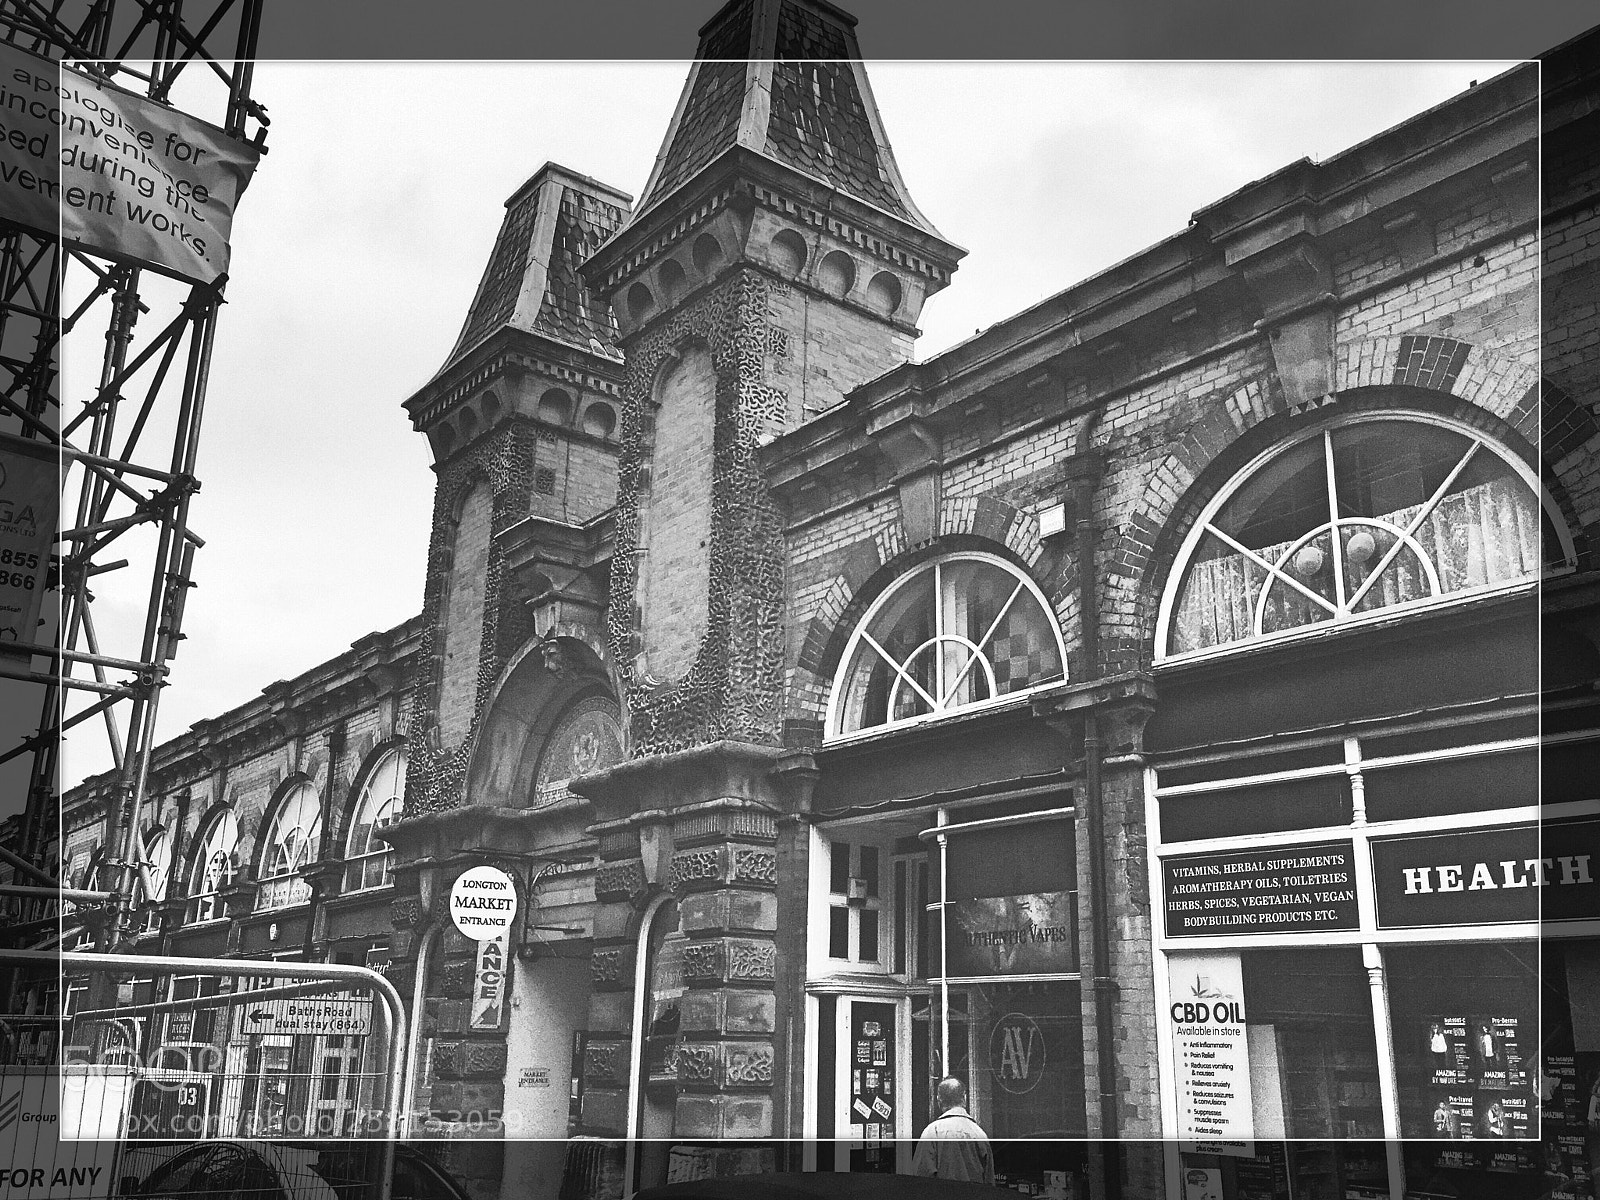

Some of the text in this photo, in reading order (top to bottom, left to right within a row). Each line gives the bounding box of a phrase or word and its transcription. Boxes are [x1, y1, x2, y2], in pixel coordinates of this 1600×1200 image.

[164, 133, 207, 165] for
[59, 144, 155, 198] during
[126, 200, 211, 262] works.
[1172, 854, 1345, 878] VITAMINS, HERBAL SUPPLEMENTS
[1402, 855, 1594, 895] HEALTH
[462, 880, 507, 890] LONGTON
[1172, 872, 1348, 895] AROMATHERAPY OILS, TOILETRIES
[454, 896, 514, 911] MARKET
[1168, 890, 1354, 911] HERBS, SPICES, VEGETARIAN, VEGAN
[459, 916, 506, 927] ENTRANCE
[1184, 909, 1338, 927] BODYBUILDING PRODUCTS ETC.
[288, 1006, 353, 1017] Baths Road
[1170, 1001, 1246, 1024] CBD OIL
[275, 1020, 300, 1029] dual
[1177, 1026, 1241, 1036] Available in store
[1484, 1071, 1506, 1079] AMAZING
[21, 1112, 57, 1125] Group
[0, 1166, 102, 1188] FOR ANY
